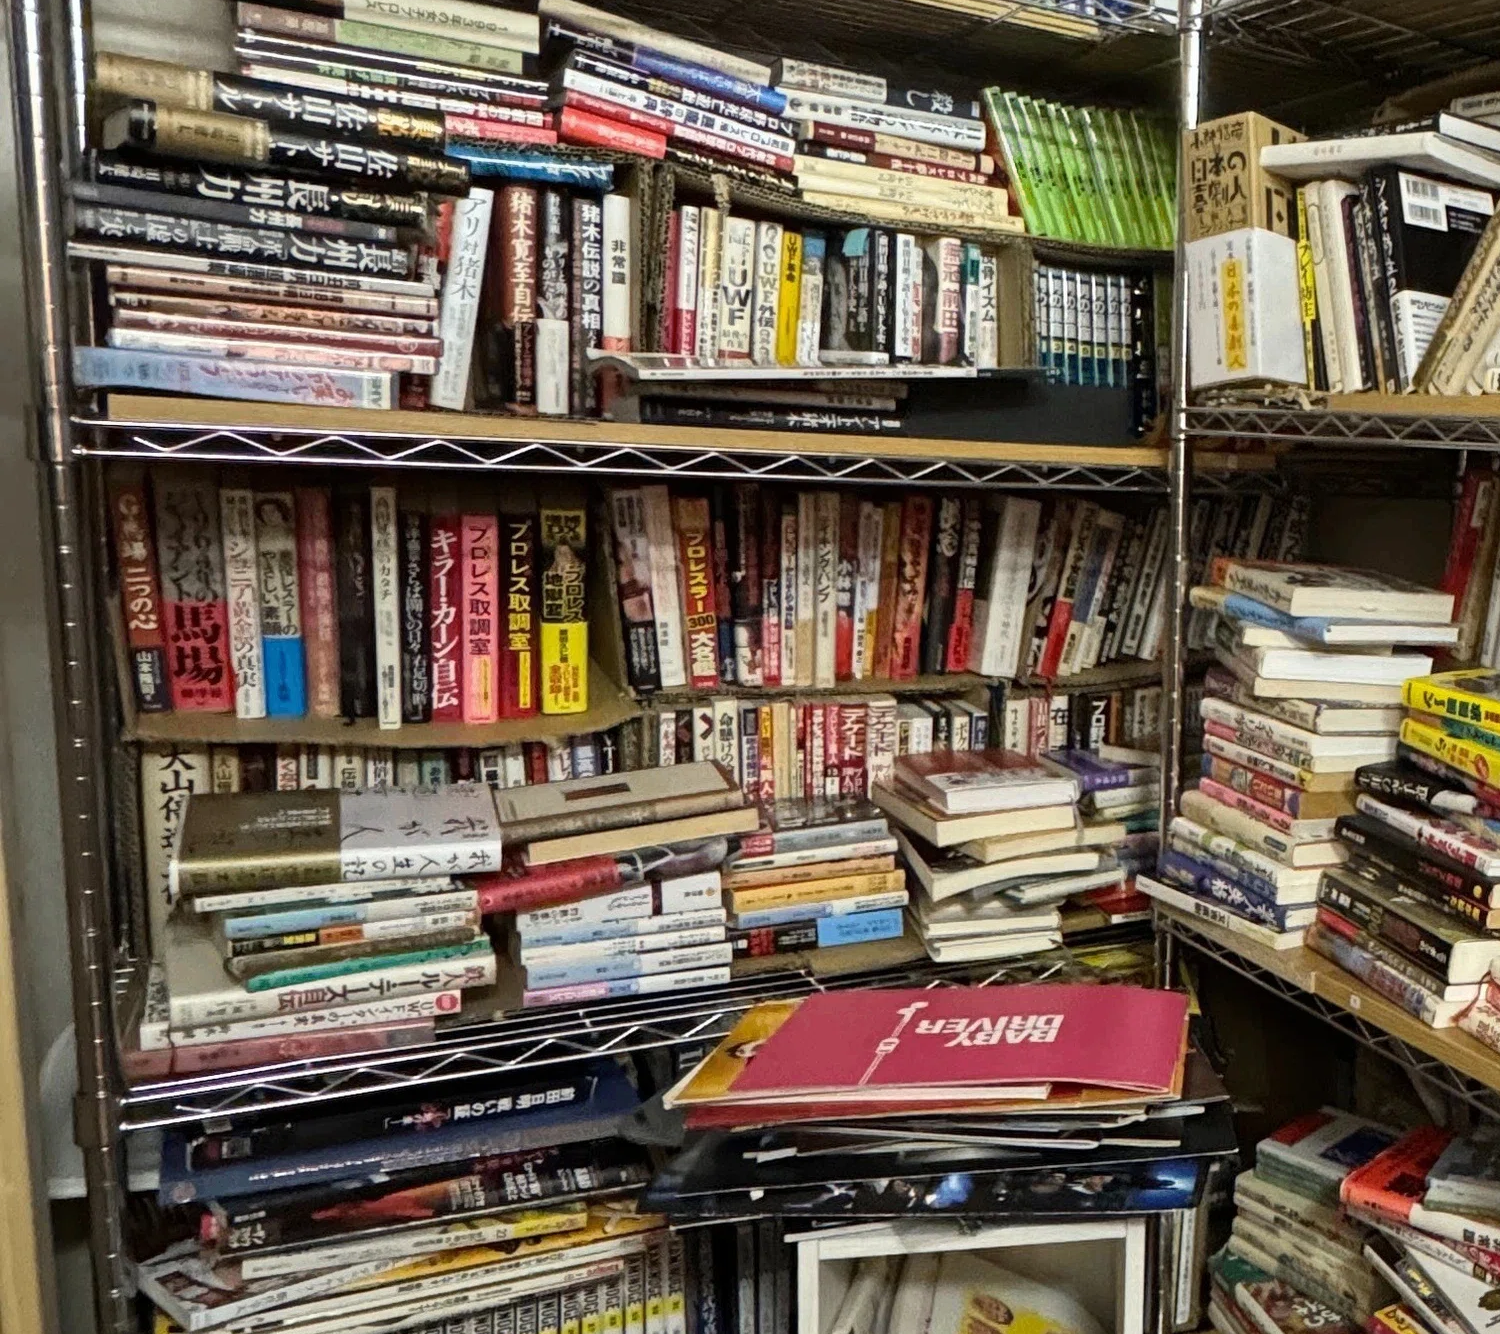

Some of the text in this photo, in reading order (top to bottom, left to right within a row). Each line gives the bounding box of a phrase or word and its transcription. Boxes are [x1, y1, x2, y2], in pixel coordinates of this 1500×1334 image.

[213, 77, 367, 135] 佐山サトル
[904, 87, 955, 115] 殺し
[267, 126, 402, 182] 佐山サト
[197, 165, 333, 216] 長州力
[288, 233, 392, 272] 長州力
[450, 196, 488, 301] アリ対猪木
[508, 193, 536, 320] 猪木寛至自伝
[580, 204, 603, 329] 猪木伝説の真相
[468, 524, 493, 657] プロレス取調室
[507, 521, 534, 653] プロレス取調室
[685, 531, 709, 614] プロレスラー
[172, 603, 222, 685] 馬場
[431, 528, 461, 709] キラー・カーン自伝
[687, 612, 715, 630] 300
[275, 963, 488, 1014] 鉄人ルー・テーズ自伝
[915, 1013, 1065, 1035] DRIVER
[945, 1027, 1059, 1048] BABY
